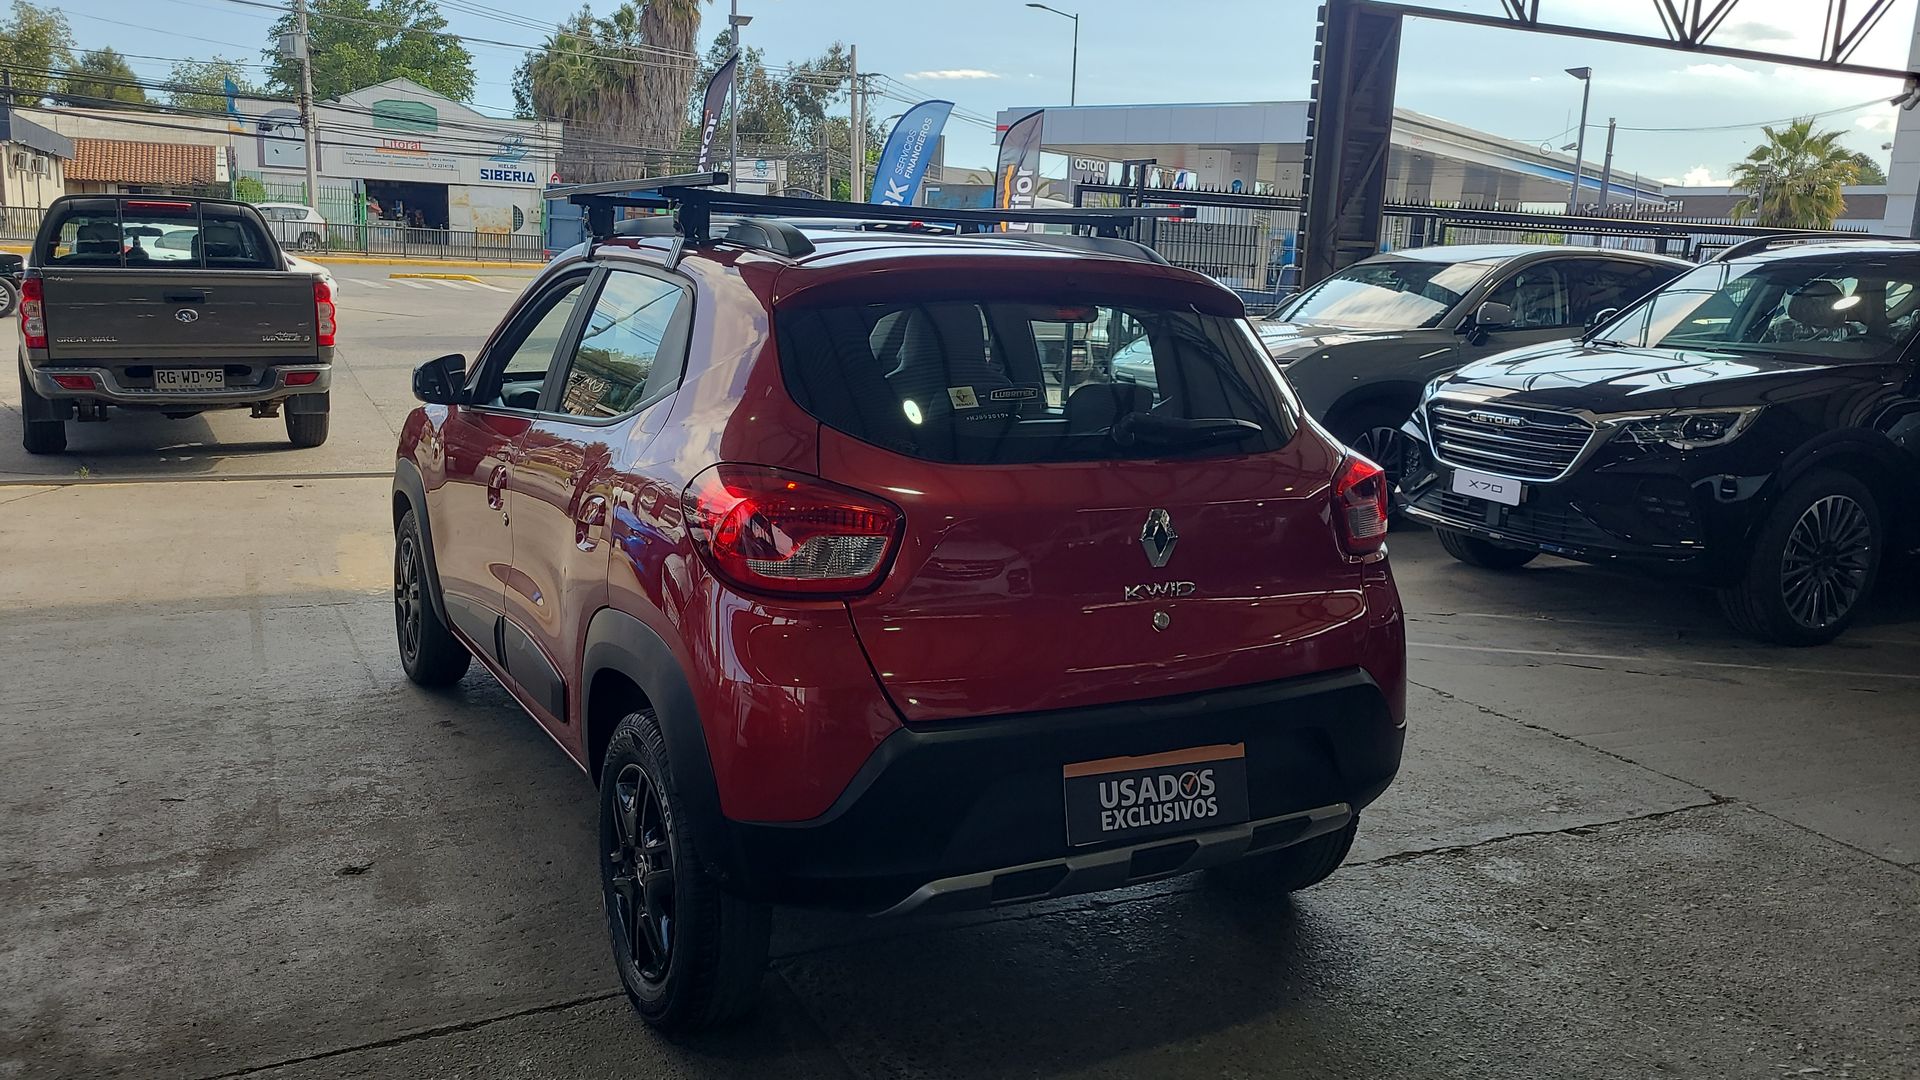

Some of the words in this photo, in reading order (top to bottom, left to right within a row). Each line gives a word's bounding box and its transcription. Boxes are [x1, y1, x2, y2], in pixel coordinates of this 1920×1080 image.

[895, 129, 917, 175] SERVICIOS
[904, 117, 933, 179] FINANCIEROS
[480, 169, 535, 182] SIBERIA
[1613, 201, 1684, 213] HYUNDAI
[1471, 413, 1520, 426] JETOUR
[1468, 480, 1503, 494] X70
[1124, 581, 1195, 601] KWID
[1100, 769, 1216, 809] USADOS
[1101, 797, 1218, 832] EXCLUSIVOS
